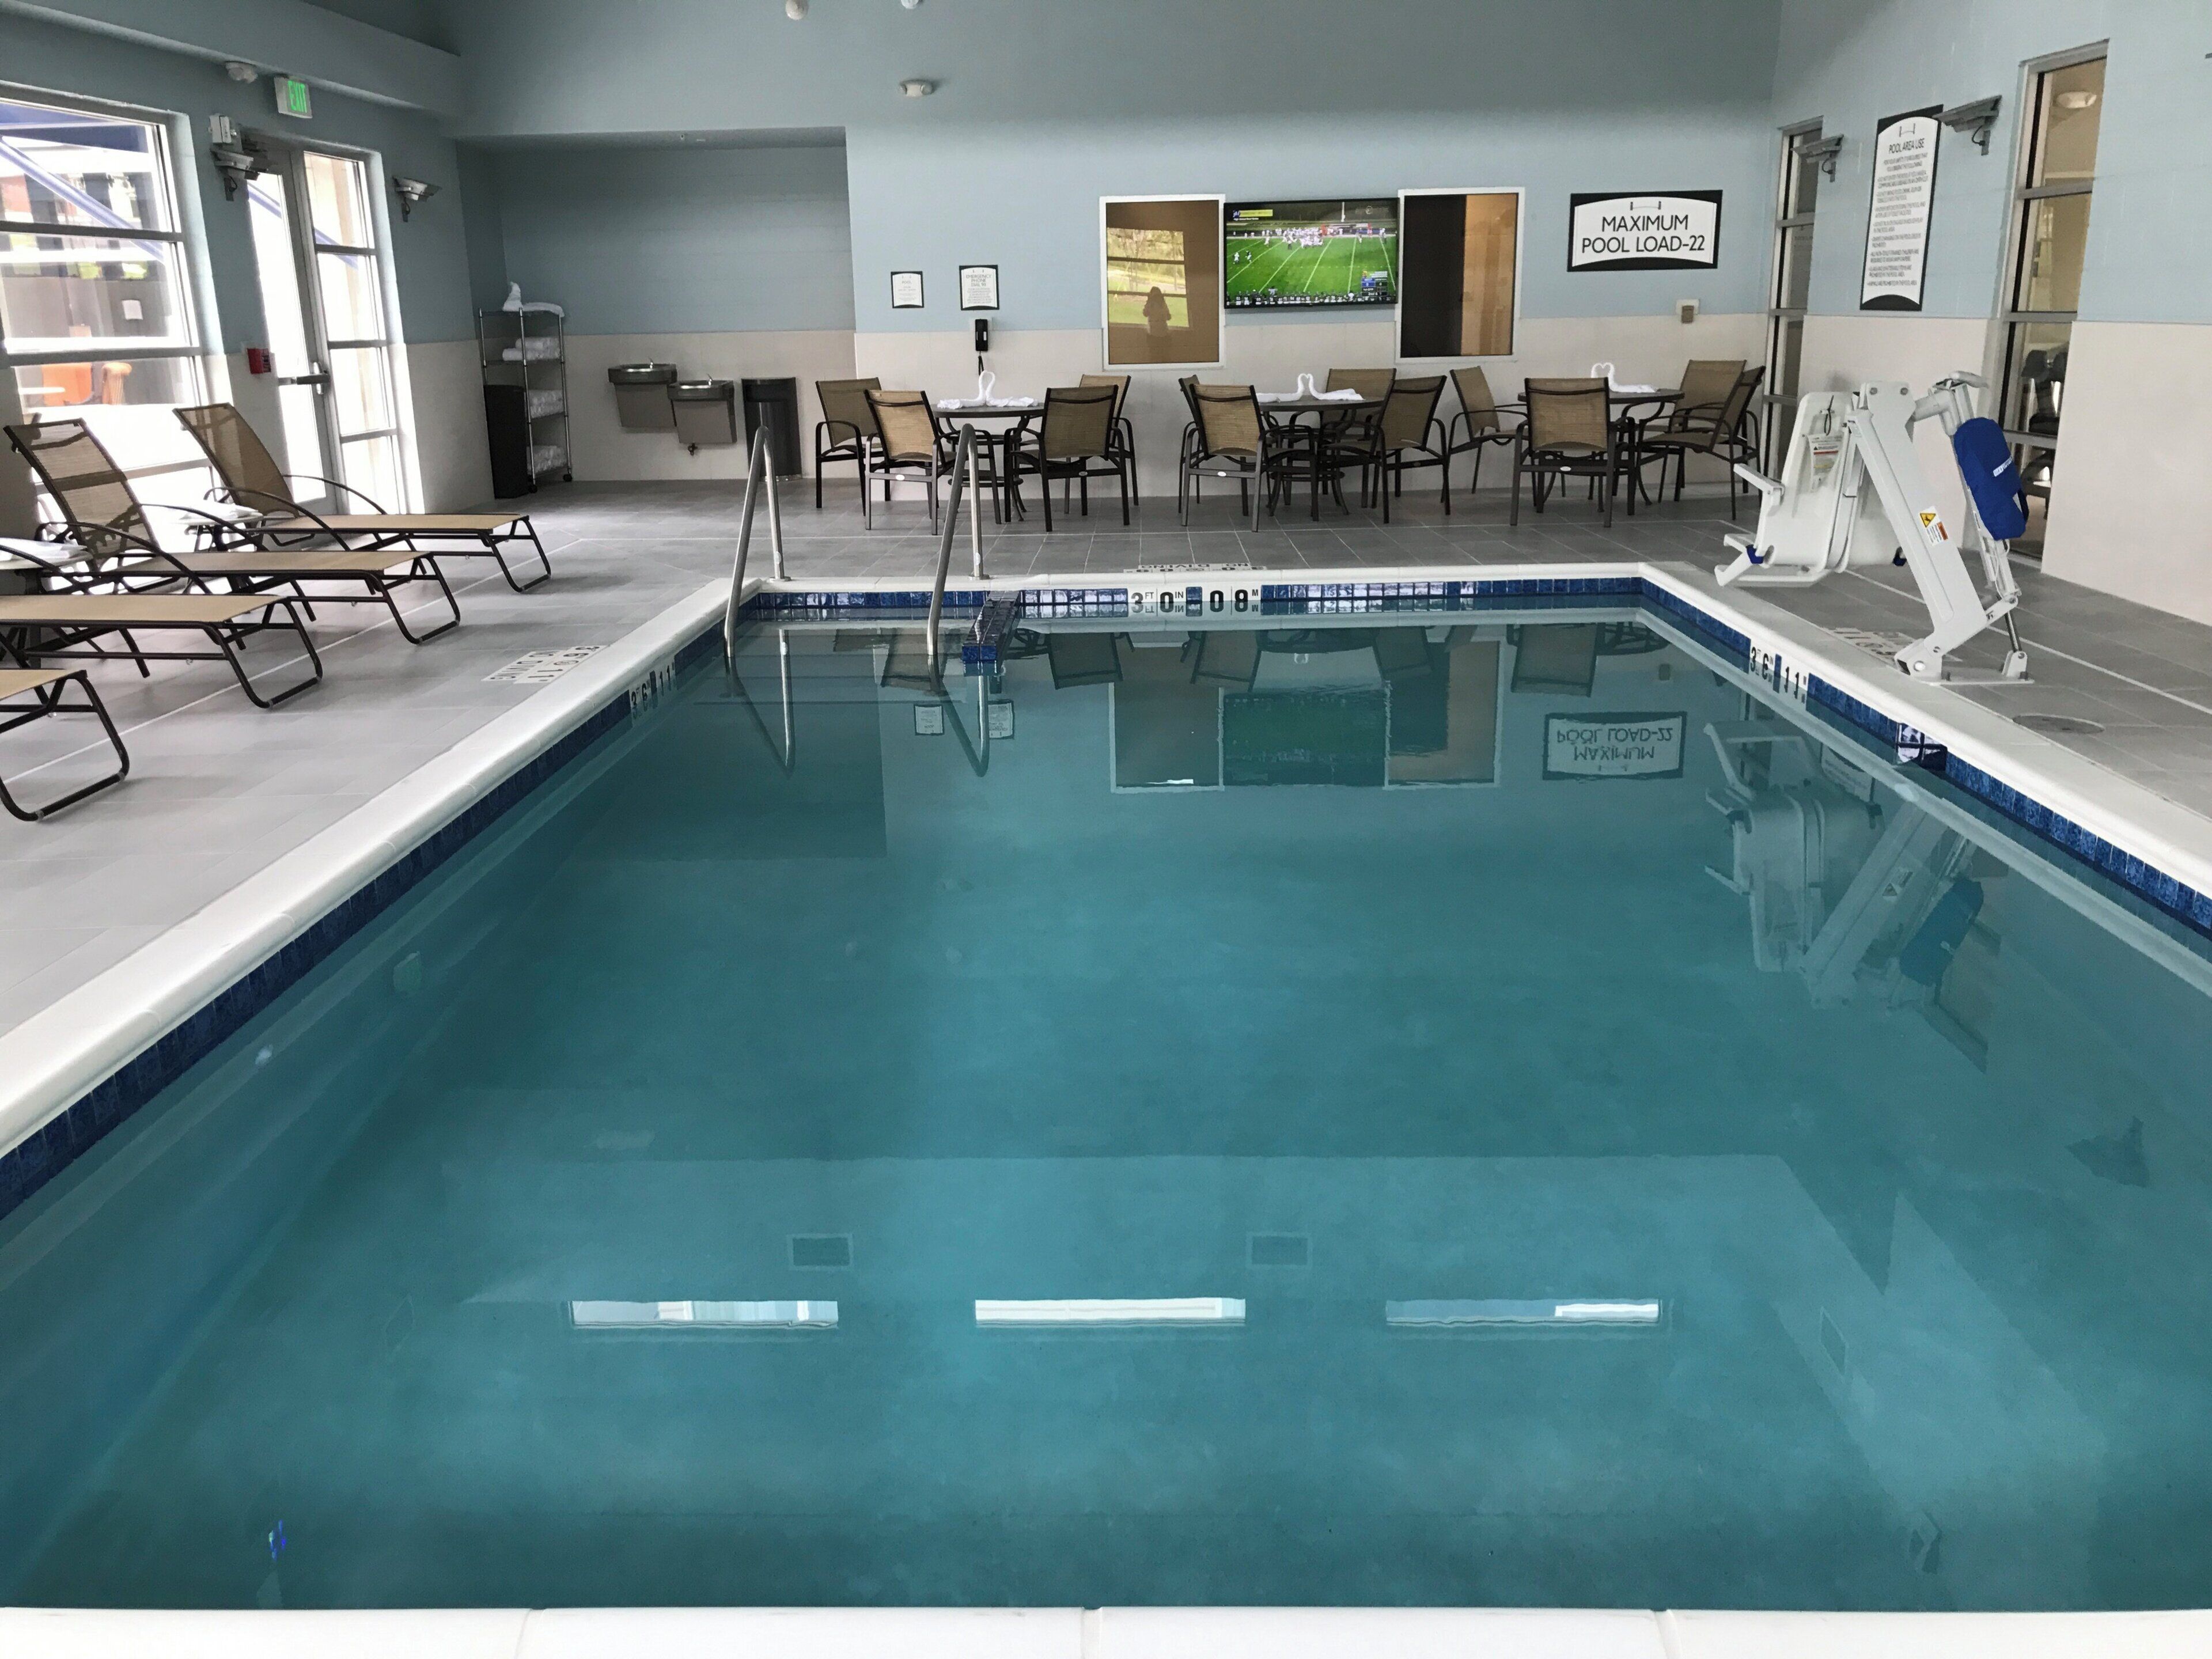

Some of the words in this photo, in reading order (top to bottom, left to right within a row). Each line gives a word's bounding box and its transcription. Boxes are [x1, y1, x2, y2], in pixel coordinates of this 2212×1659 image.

[287, 80, 307, 113] EXIT
[1889, 143, 1902, 154] POOL
[1902, 141, 1914, 150] AREA
[1915, 138, 1925, 149] USE
[1602, 214, 1688, 232] MAXIMUM
[1582, 237, 1630, 253] POOL
[1636, 235, 1705, 252] LOAD-22
